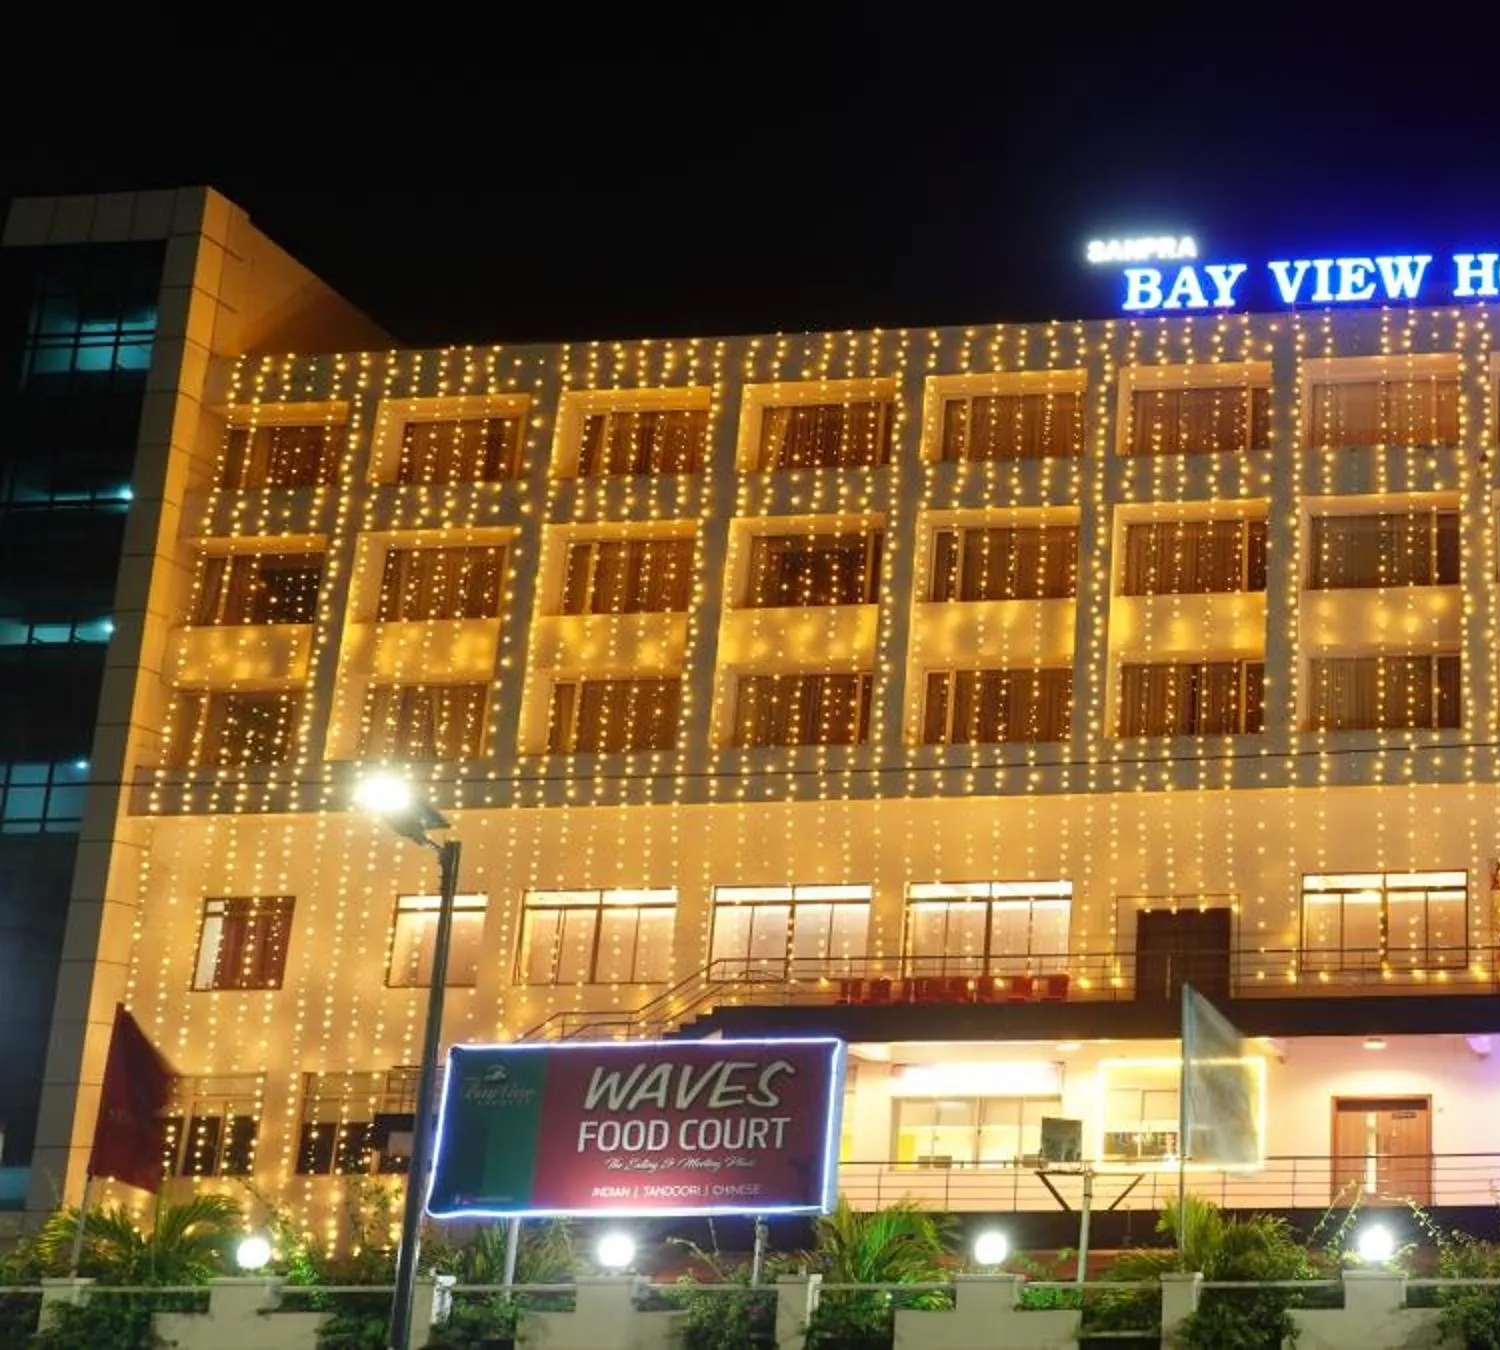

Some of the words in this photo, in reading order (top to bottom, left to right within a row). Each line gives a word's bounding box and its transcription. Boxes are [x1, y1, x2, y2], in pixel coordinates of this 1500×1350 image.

[1087, 238, 1197, 262] SANPRA
[1123, 264, 1246, 310] BAY
[1268, 256, 1431, 303] VIEW
[584, 1061, 795, 1112] WAVES
[577, 1120, 669, 1152] FOOD
[679, 1117, 791, 1151] COURT
[591, 1186, 632, 1198] INDIAN
[712, 1183, 761, 1196] CHINESE
